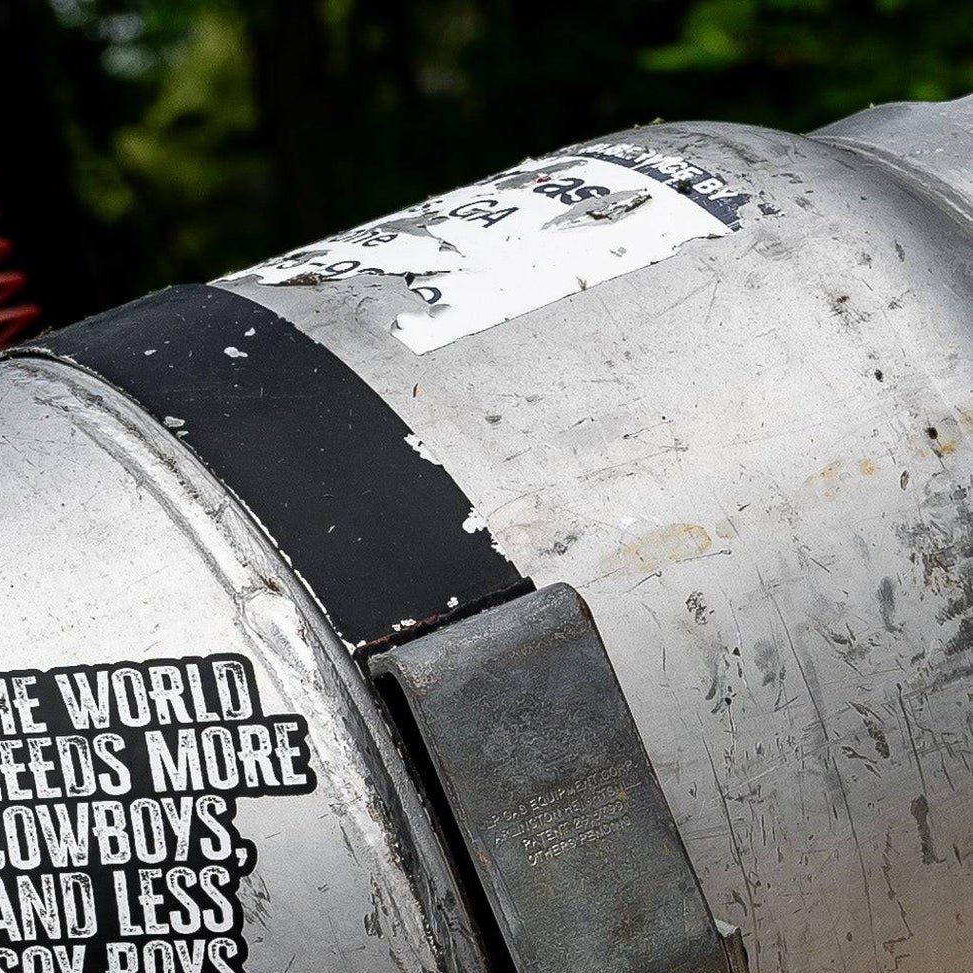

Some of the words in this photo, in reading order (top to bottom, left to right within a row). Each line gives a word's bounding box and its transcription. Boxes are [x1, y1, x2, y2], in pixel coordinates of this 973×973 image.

[55, 661, 254, 730] WORLD
[144, 722, 307, 793] MORE
[113, 867, 234, 936] LESS
